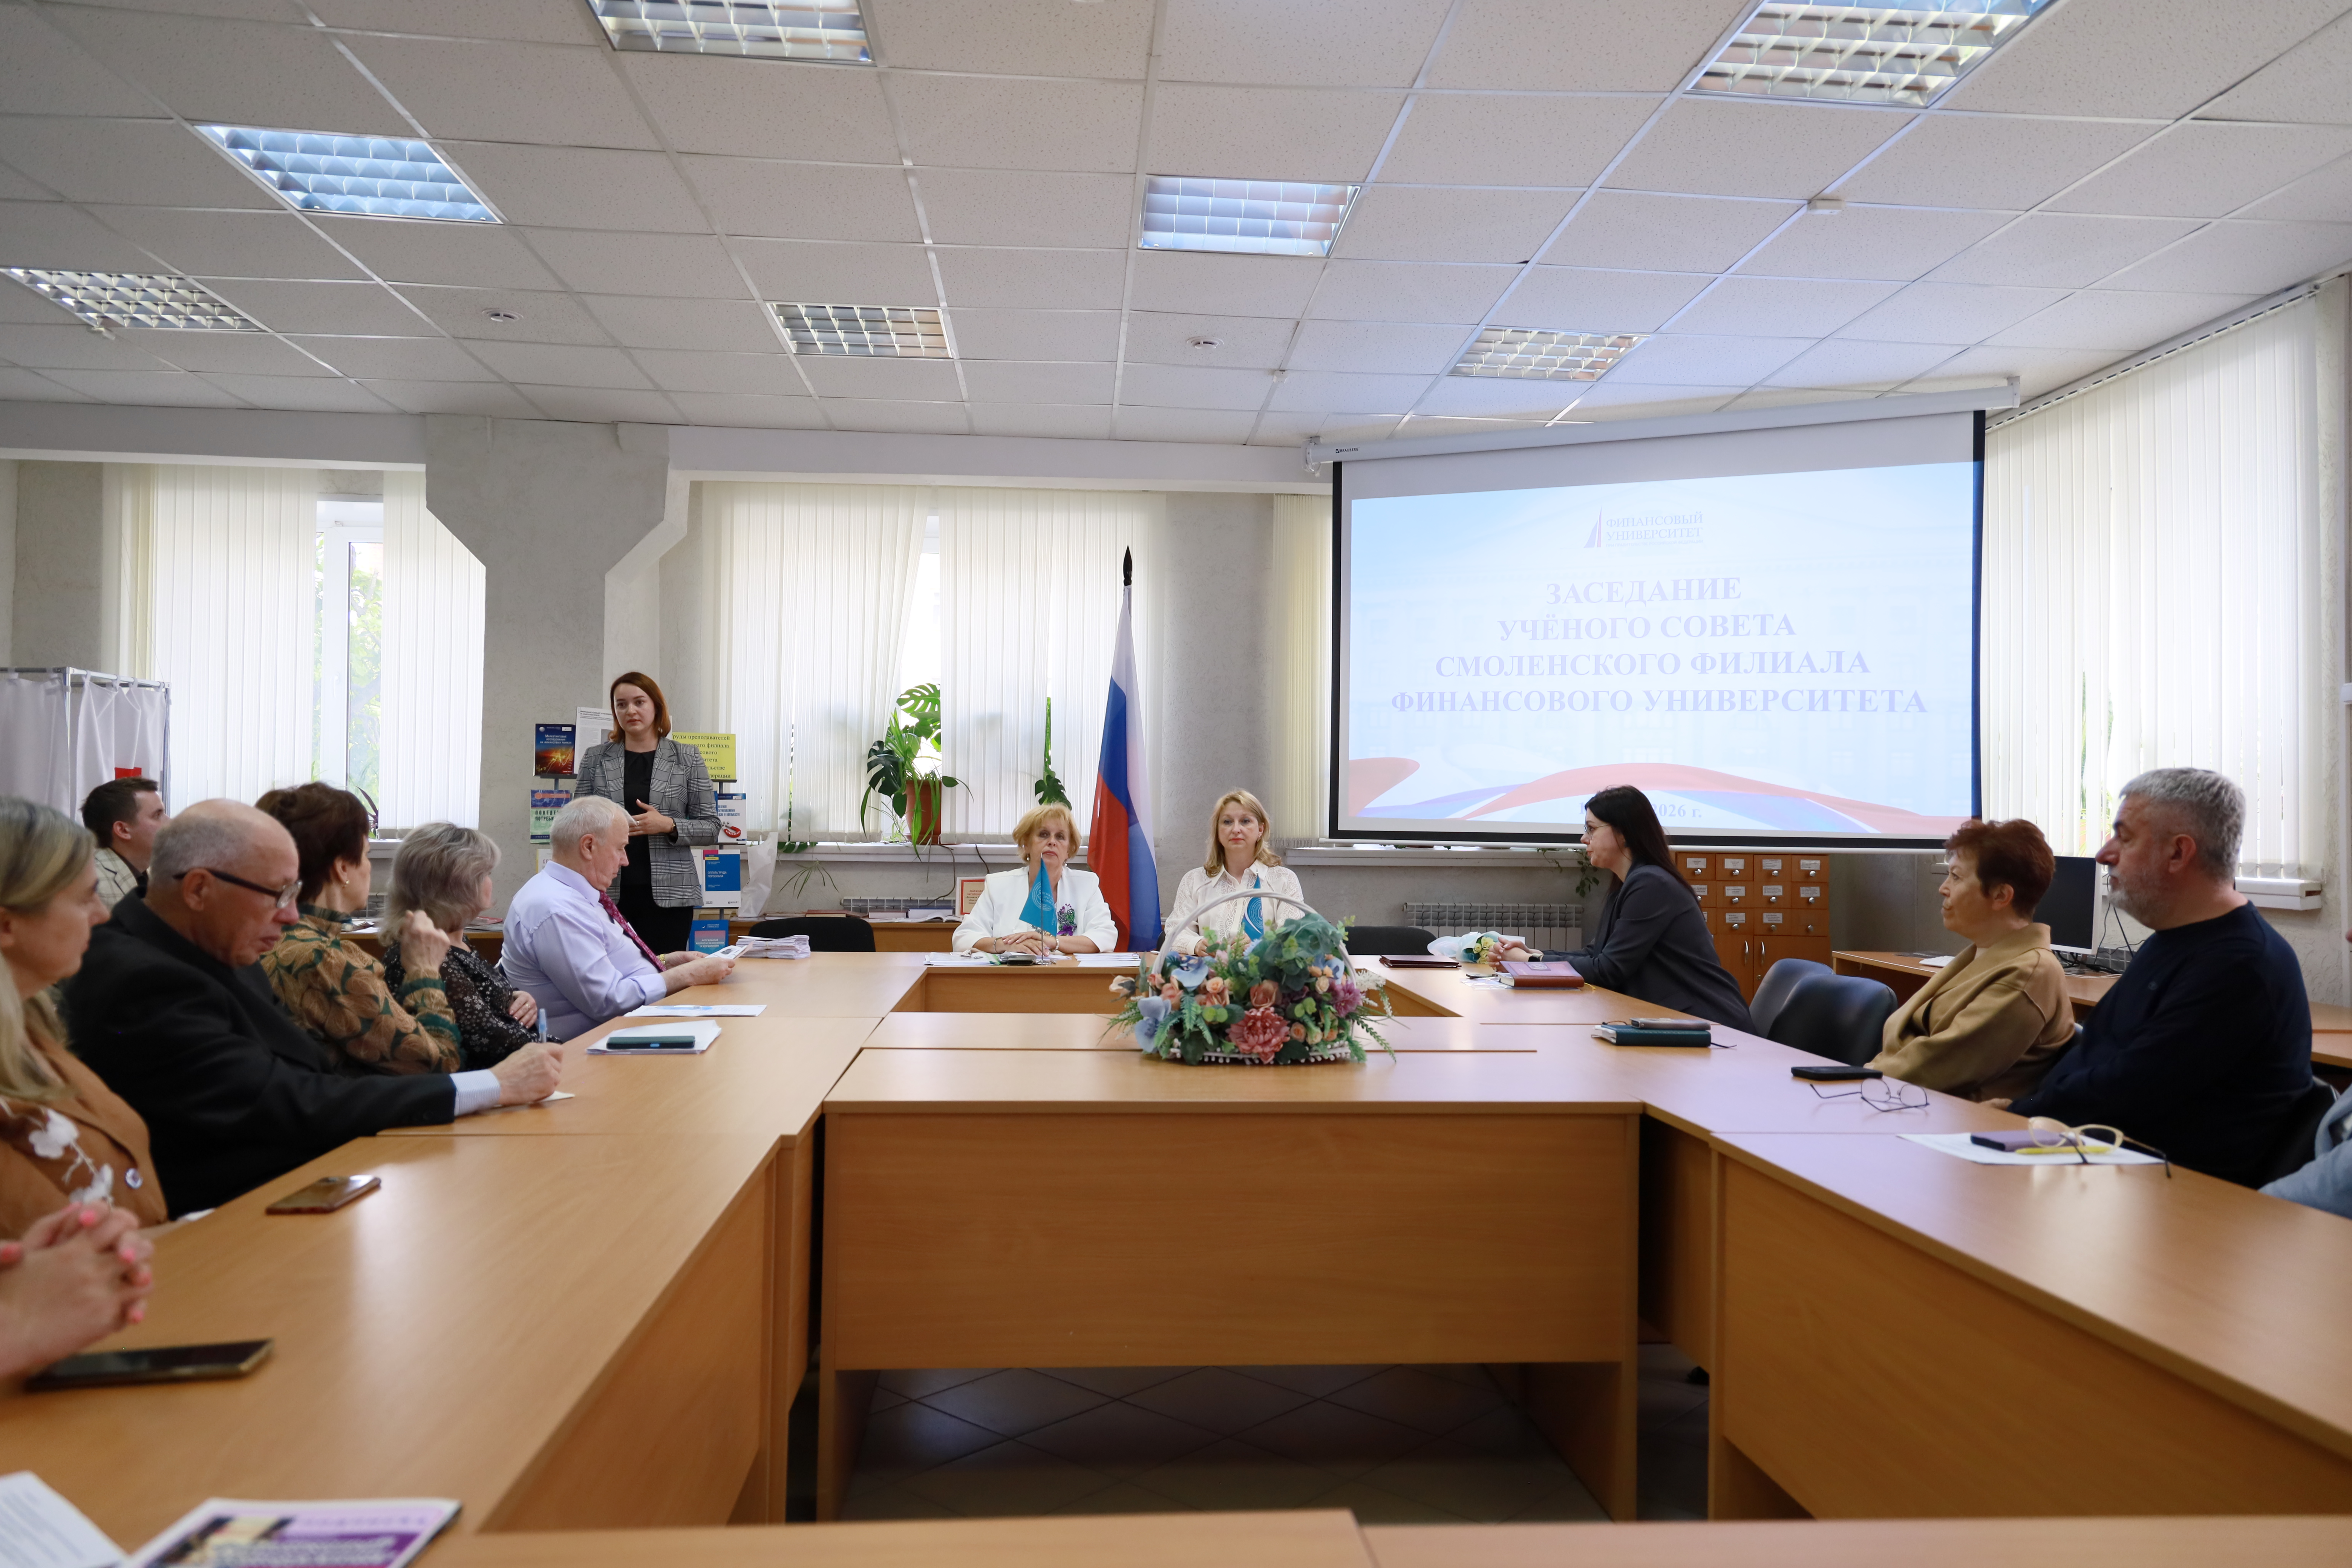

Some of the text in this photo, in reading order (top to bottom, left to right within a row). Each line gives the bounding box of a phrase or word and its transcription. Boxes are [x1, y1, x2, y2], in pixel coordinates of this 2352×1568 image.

[1606, 511, 1703, 528] ФИНАНСОВЫЙ
[1606, 527, 1703, 541] УНИВЕРСИТЕТ
[1546, 577, 1742, 608] ЗАСЕДАНИЕ
[1498, 613, 1797, 642] УЧЁНОГО СОВЕТА
[1435, 651, 1872, 678] СМОЛЕНСКОГО ФИЛИАЛА
[1391, 689, 1929, 713] ФИНАНСОВОГО УНИВЕРСИТЕТА
[1692, 809, 1702, 818] г.
